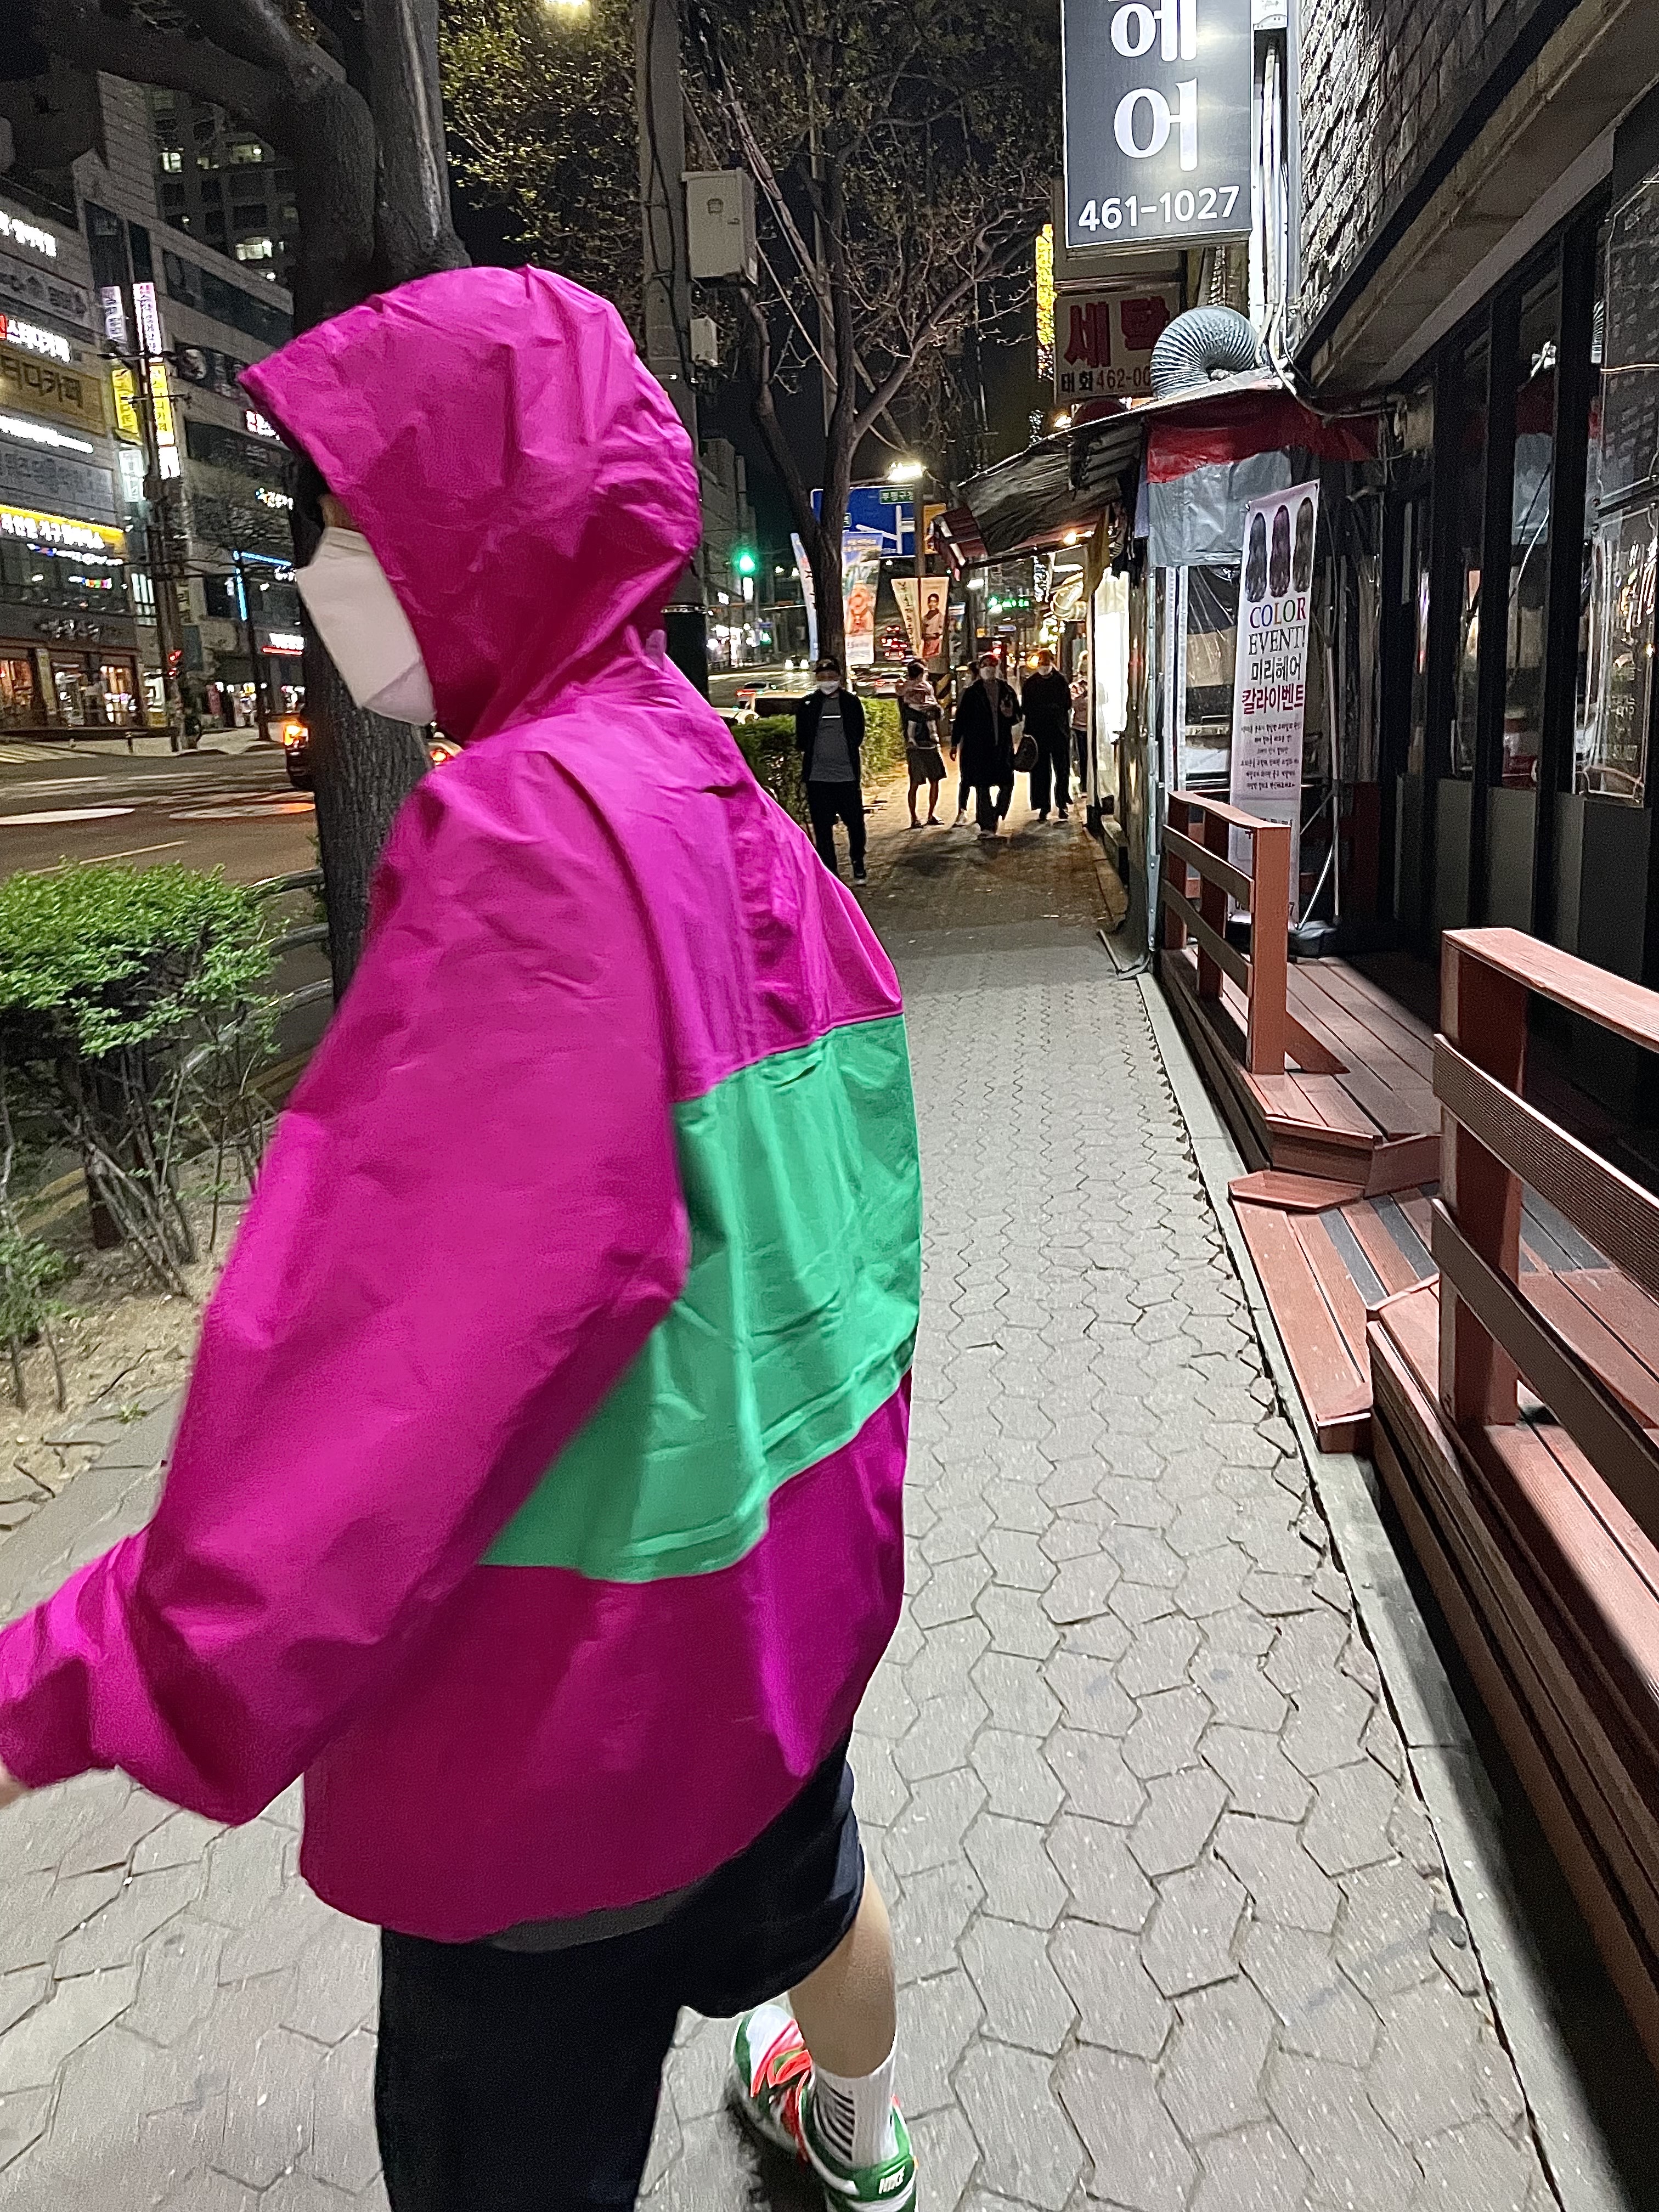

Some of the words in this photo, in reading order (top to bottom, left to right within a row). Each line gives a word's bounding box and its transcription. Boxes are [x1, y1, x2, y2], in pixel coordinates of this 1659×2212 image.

[1078, 185, 1240, 232] 461-1027
[1250, 597, 1306, 629] COLOR
[1248, 625, 1306, 656] EVENT!
[1251, 653, 1301, 685] 미리헤어
[1242, 683, 1304, 715] 칼라이벤트
